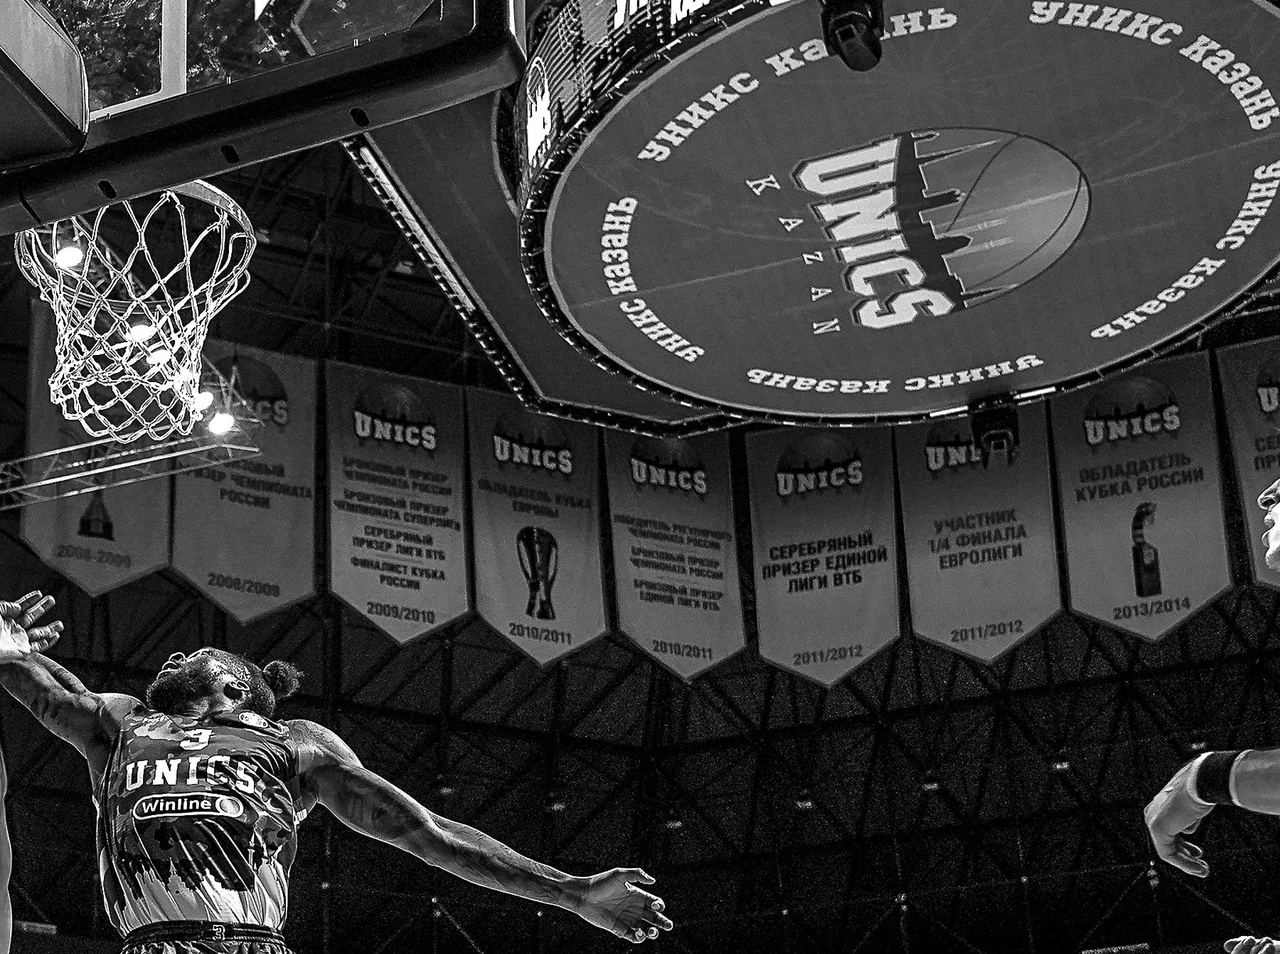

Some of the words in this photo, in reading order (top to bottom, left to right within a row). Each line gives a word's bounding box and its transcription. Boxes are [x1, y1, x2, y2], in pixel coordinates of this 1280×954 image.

[794, 135, 955, 330] UNICS
[353, 410, 437, 451] UNICS
[1084, 404, 1180, 446] UNICS
[492, 434, 573, 475] UNICS
[1079, 452, 1191, 484] ОБЛАДАТЕЛЬ
[630, 457, 708, 495] UNICS
[776, 460, 863, 496] UNICS
[1075, 481, 1132, 503] КУБКА
[1137, 466, 1204, 493] РОССИИ
[933, 508, 1017, 534] УЧАСТНИК
[770, 533, 873, 561] СЕРЕБРЯНЫЙ
[929, 535, 953, 554] 1/4
[955, 524, 1027, 550] ФИНАЛА
[762, 558, 820, 580] ПРИЗЕР
[825, 546, 888, 571] ЕДИНОЙ
[938, 544, 1023, 571] ЕВРОЛИГИ
[379, 574, 421, 591] РОССИИ
[411, 566, 445, 581] КУБКА
[788, 573, 828, 593] ЛИГИ
[833, 569, 862, 588] ВТБ
[367, 602, 436, 624] 2009/2010
[1113, 597, 1191, 621] 2013/2014
[509, 622, 572, 645] 2010/2011
[951, 619, 1024, 644] 2011/2012
[652, 640, 713, 660] 2010/2011
[793, 644, 863, 666] 2011/2012
[126, 756, 259, 795] UNICS
[141, 797, 212, 814] Winline
[212, 924, 226, 942] 3
